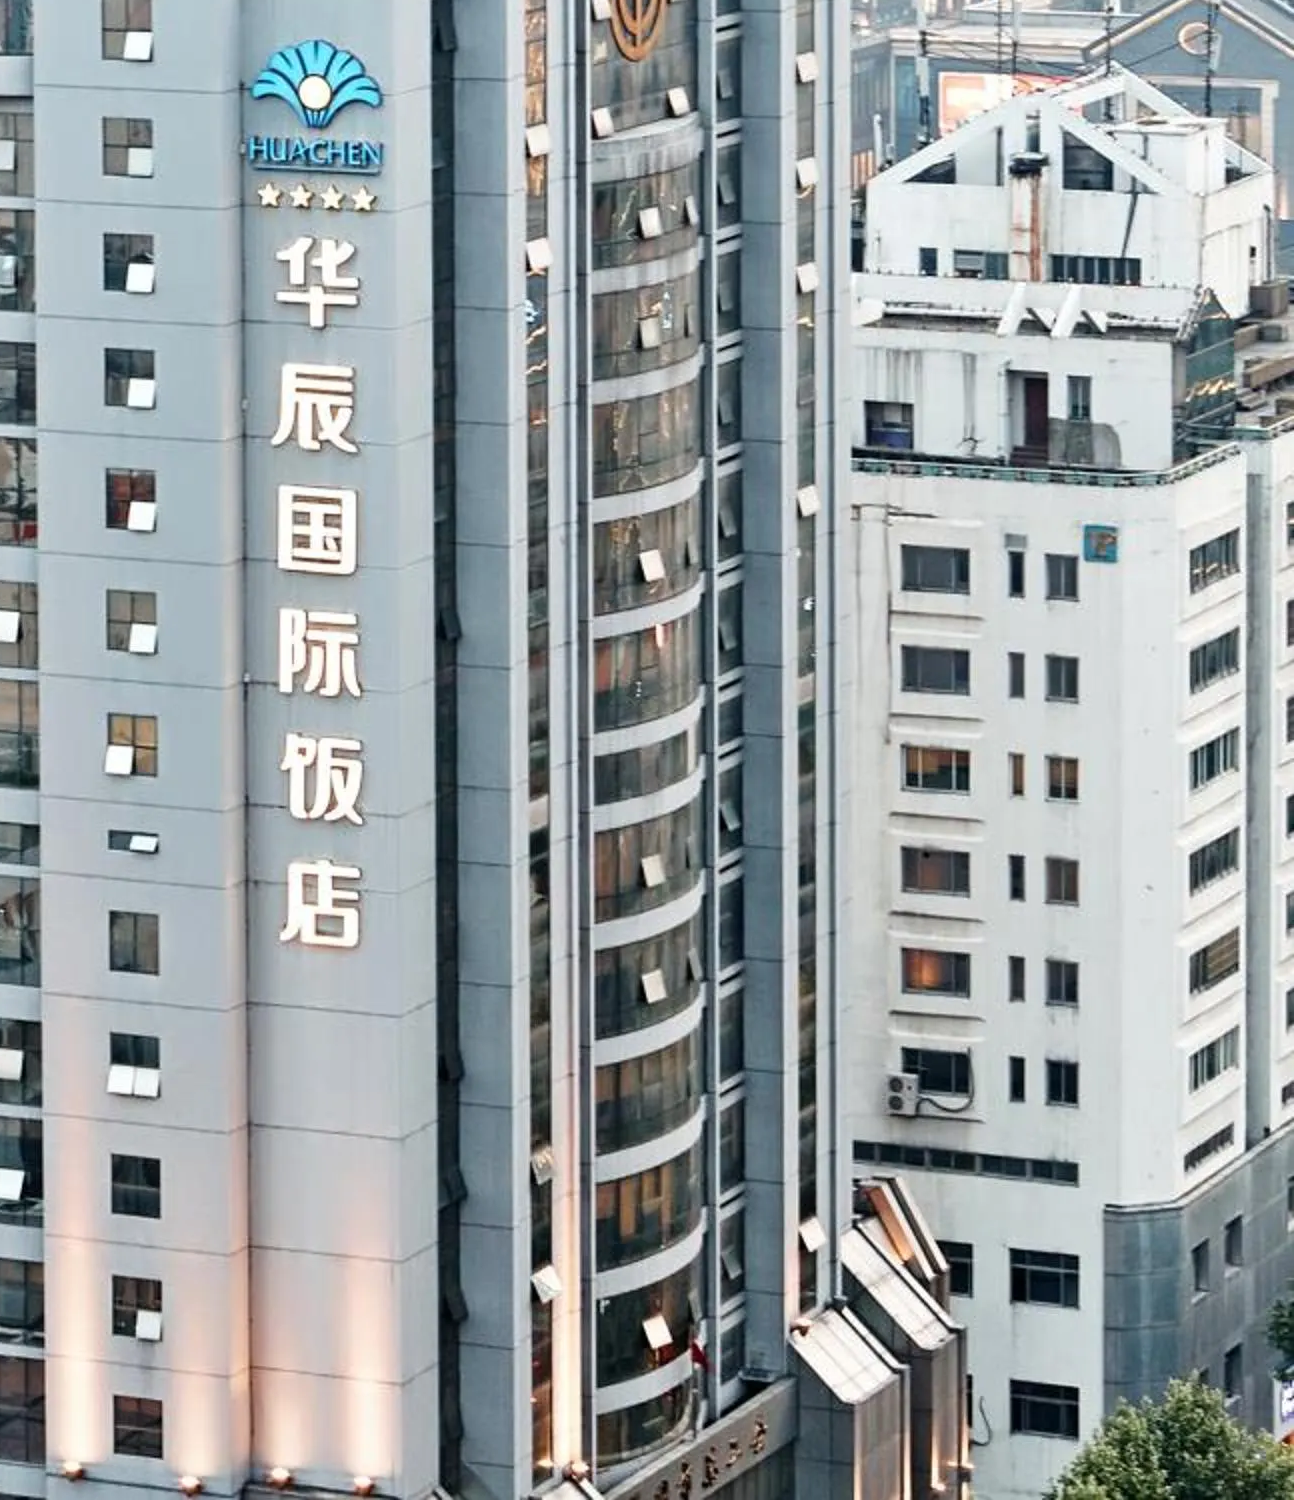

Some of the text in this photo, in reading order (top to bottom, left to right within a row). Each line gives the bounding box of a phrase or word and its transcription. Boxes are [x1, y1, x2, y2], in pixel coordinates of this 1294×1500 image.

[248, 136, 384, 167] HUACHEN
[270, 236, 364, 949] 华辰国际饭店
